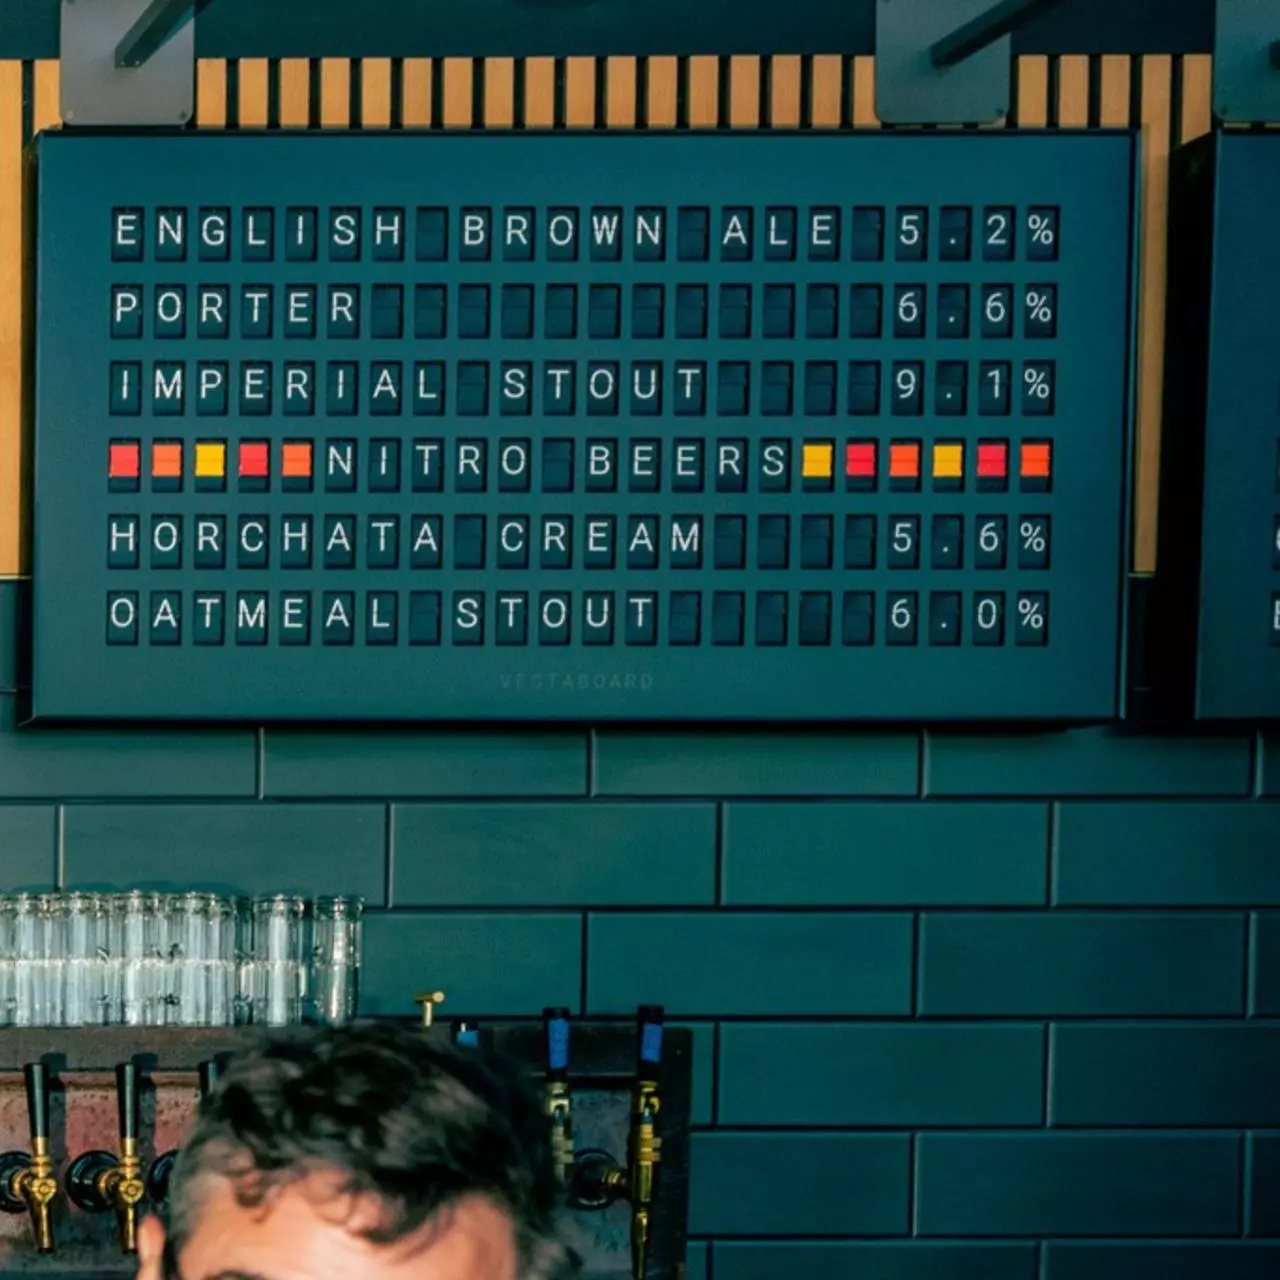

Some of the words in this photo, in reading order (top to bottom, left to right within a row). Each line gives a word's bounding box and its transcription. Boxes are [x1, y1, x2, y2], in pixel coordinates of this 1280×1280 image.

[117, 215, 399, 246] ENGLISH
[464, 215, 660, 246] BROWN
[723, 215, 832, 245] ALE
[900, 214, 1053, 245] 5.2%
[116, 292, 353, 322] PORTER
[898, 291, 1051, 322] 6.6%
[122, 369, 437, 399] IMPERIAL
[503, 368, 700, 399] STOUT
[896, 368, 1049, 399] 9.1%
[328, 445, 526, 475] NITRO
[590, 445, 784, 476] BEERS
[111, 522, 437, 552] HORCHATA
[501, 522, 699, 552] CREAM
[893, 522, 1045, 552] 5.6%
[111, 598, 390, 628] OATMEAL
[456, 598, 652, 628] STOUT
[891, 598, 1043, 629] 6.0%
